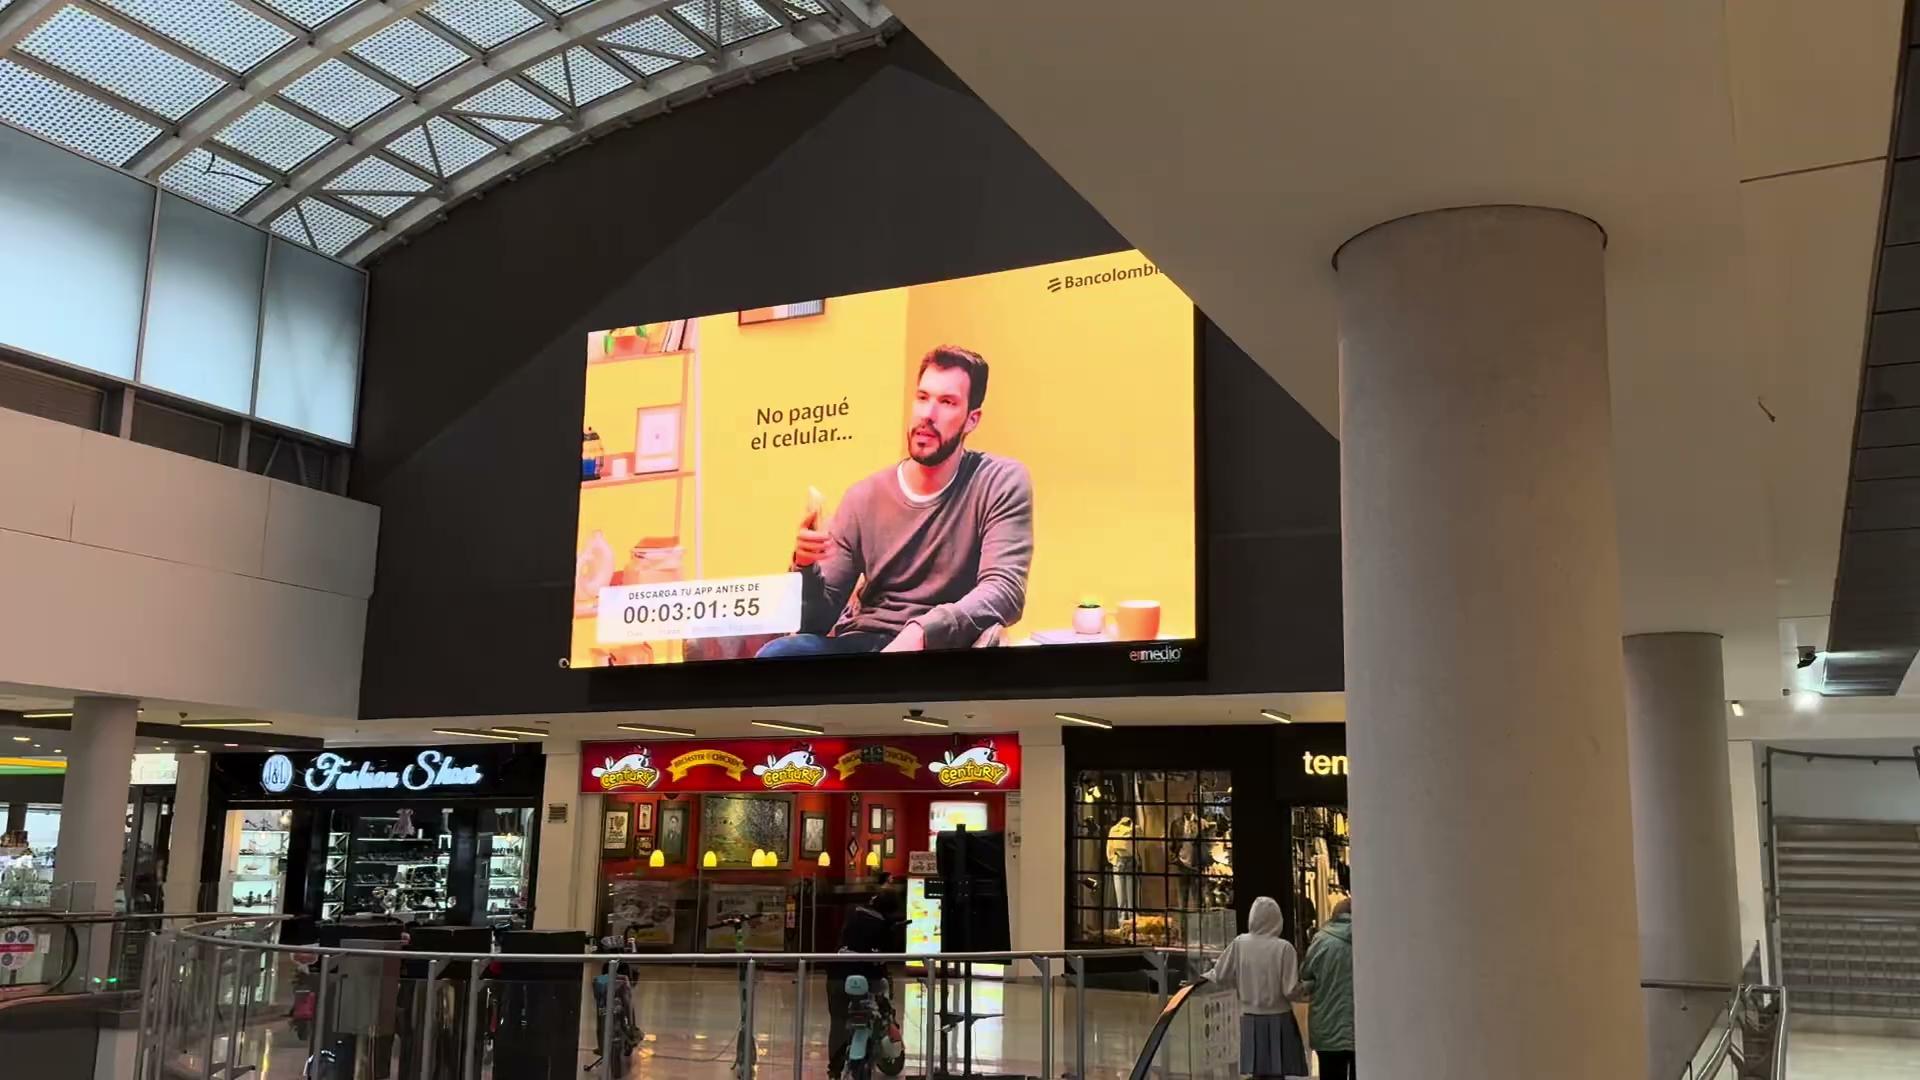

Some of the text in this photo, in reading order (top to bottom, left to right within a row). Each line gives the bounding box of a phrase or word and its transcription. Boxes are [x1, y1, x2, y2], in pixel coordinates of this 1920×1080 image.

[1065, 263, 1160, 288] Bancolombi
[757, 396, 849, 426] No pagué
[751, 426, 853, 450] el celular...
[628, 583, 760, 600] DESCARGA TU APP ANTES DE
[1302, 751, 1348, 775] ten
